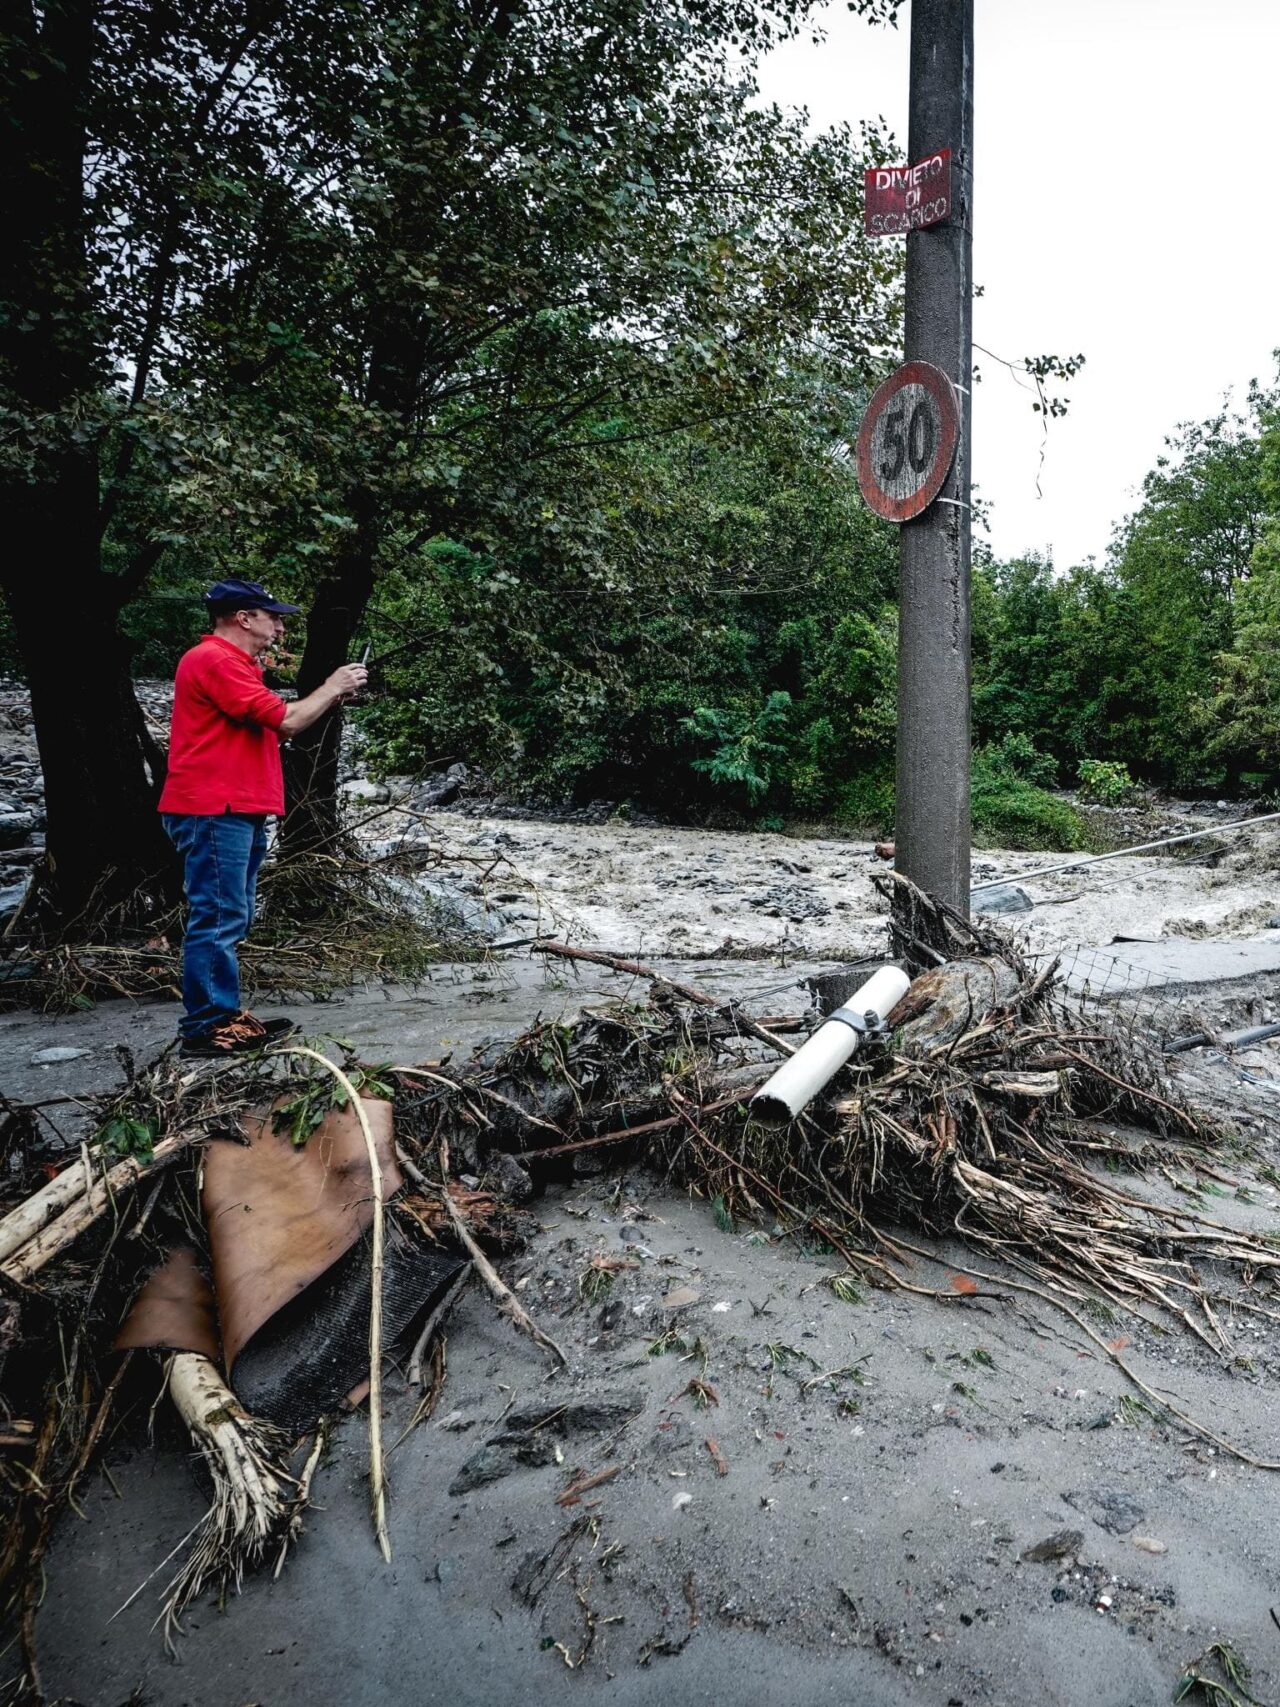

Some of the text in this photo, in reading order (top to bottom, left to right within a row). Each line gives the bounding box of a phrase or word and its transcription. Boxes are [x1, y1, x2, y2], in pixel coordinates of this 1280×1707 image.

[876, 155, 943, 190] DIVIETO
[871, 197, 947, 233] SCARICO
[905, 187, 921, 209] DI
[880, 402, 932, 481] 50
